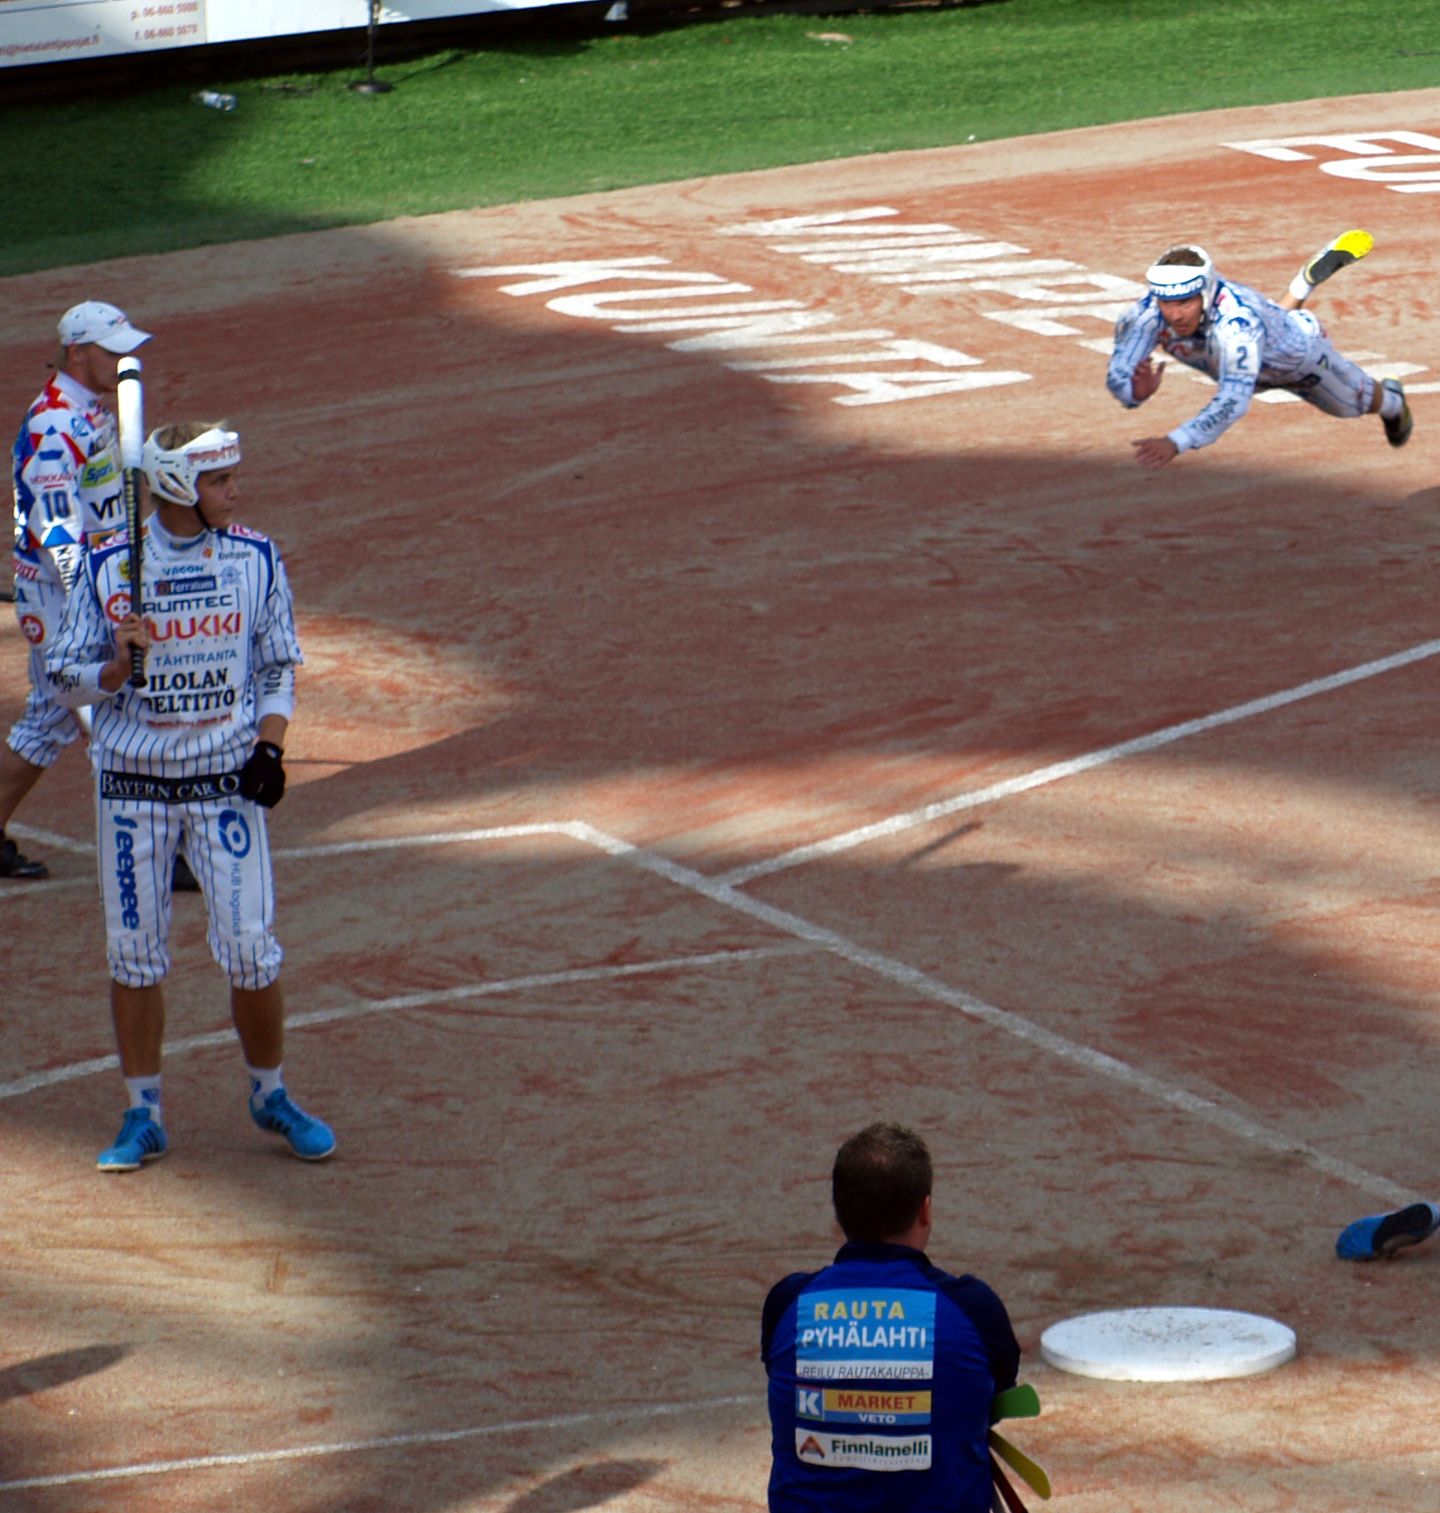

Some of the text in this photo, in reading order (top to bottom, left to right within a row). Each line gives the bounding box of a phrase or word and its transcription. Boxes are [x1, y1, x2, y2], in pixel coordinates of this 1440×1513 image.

[449, 255, 1033, 406] KUNTA
[1236, 346, 1249, 370] 2
[41, 490, 71, 522] 10
[145, 612, 241, 642] UUKKI
[102, 772, 169, 799] BAYERN
[176, 783, 214, 798] CAR
[814, 1300, 905, 1322] RAUTA
[801, 1321, 927, 1349] PYHÄLAHTI
[798, 1389, 916, 1415] K MARKET
[858, 1413, 896, 1424] VETO
[831, 1438, 929, 1457] Finnlamelli
